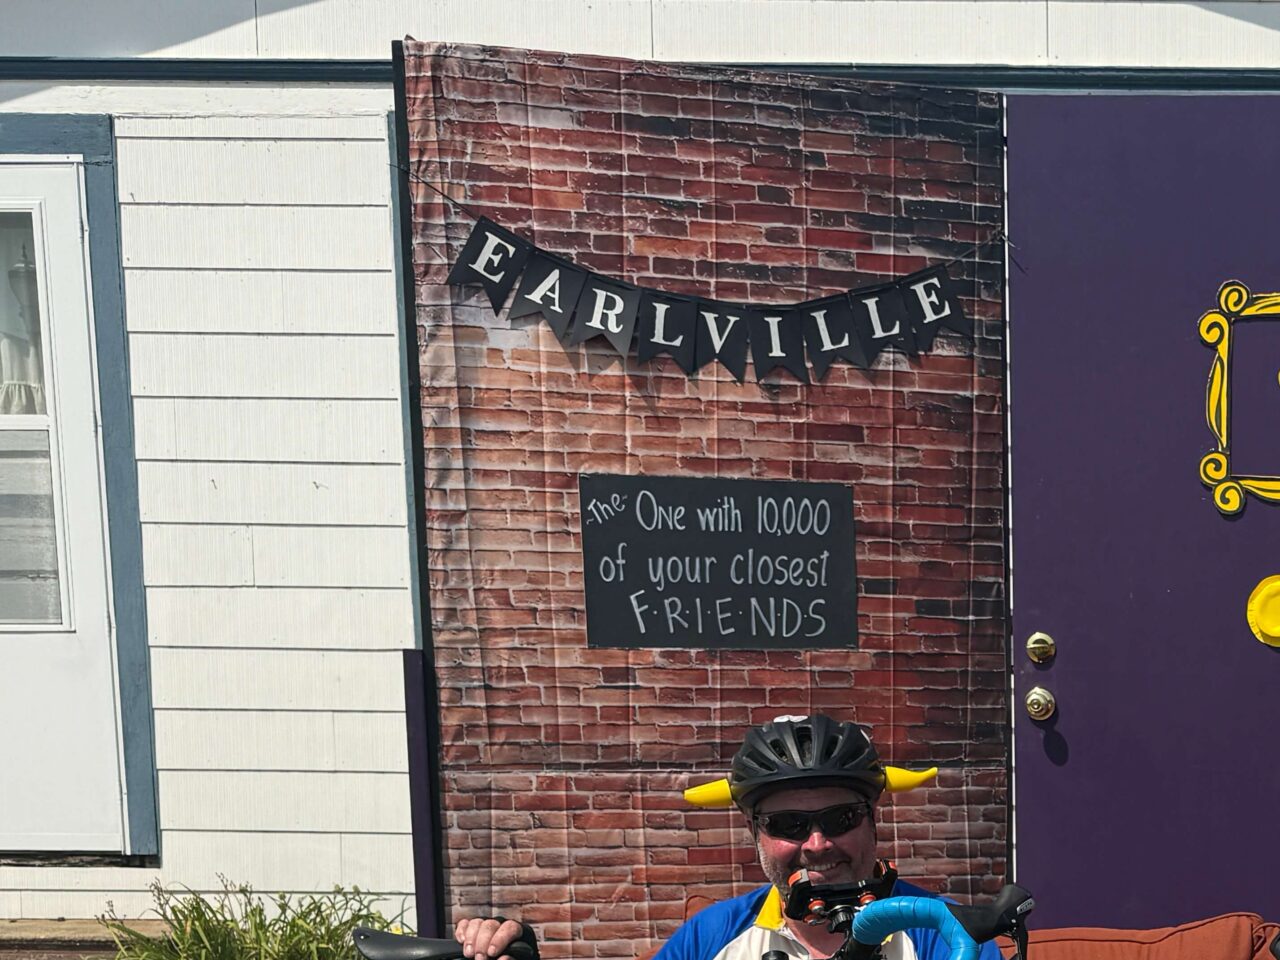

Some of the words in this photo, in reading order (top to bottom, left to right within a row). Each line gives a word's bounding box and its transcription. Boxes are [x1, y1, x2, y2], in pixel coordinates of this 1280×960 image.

[468, 232, 951, 358] EARLVILLE
[636, 490, 686, 532] One
[697, 497, 743, 534] with
[757, 496, 832, 537] 10,000
[599, 542, 627, 583] of
[648, 556, 718, 591] your
[730, 547, 830, 588] closest
